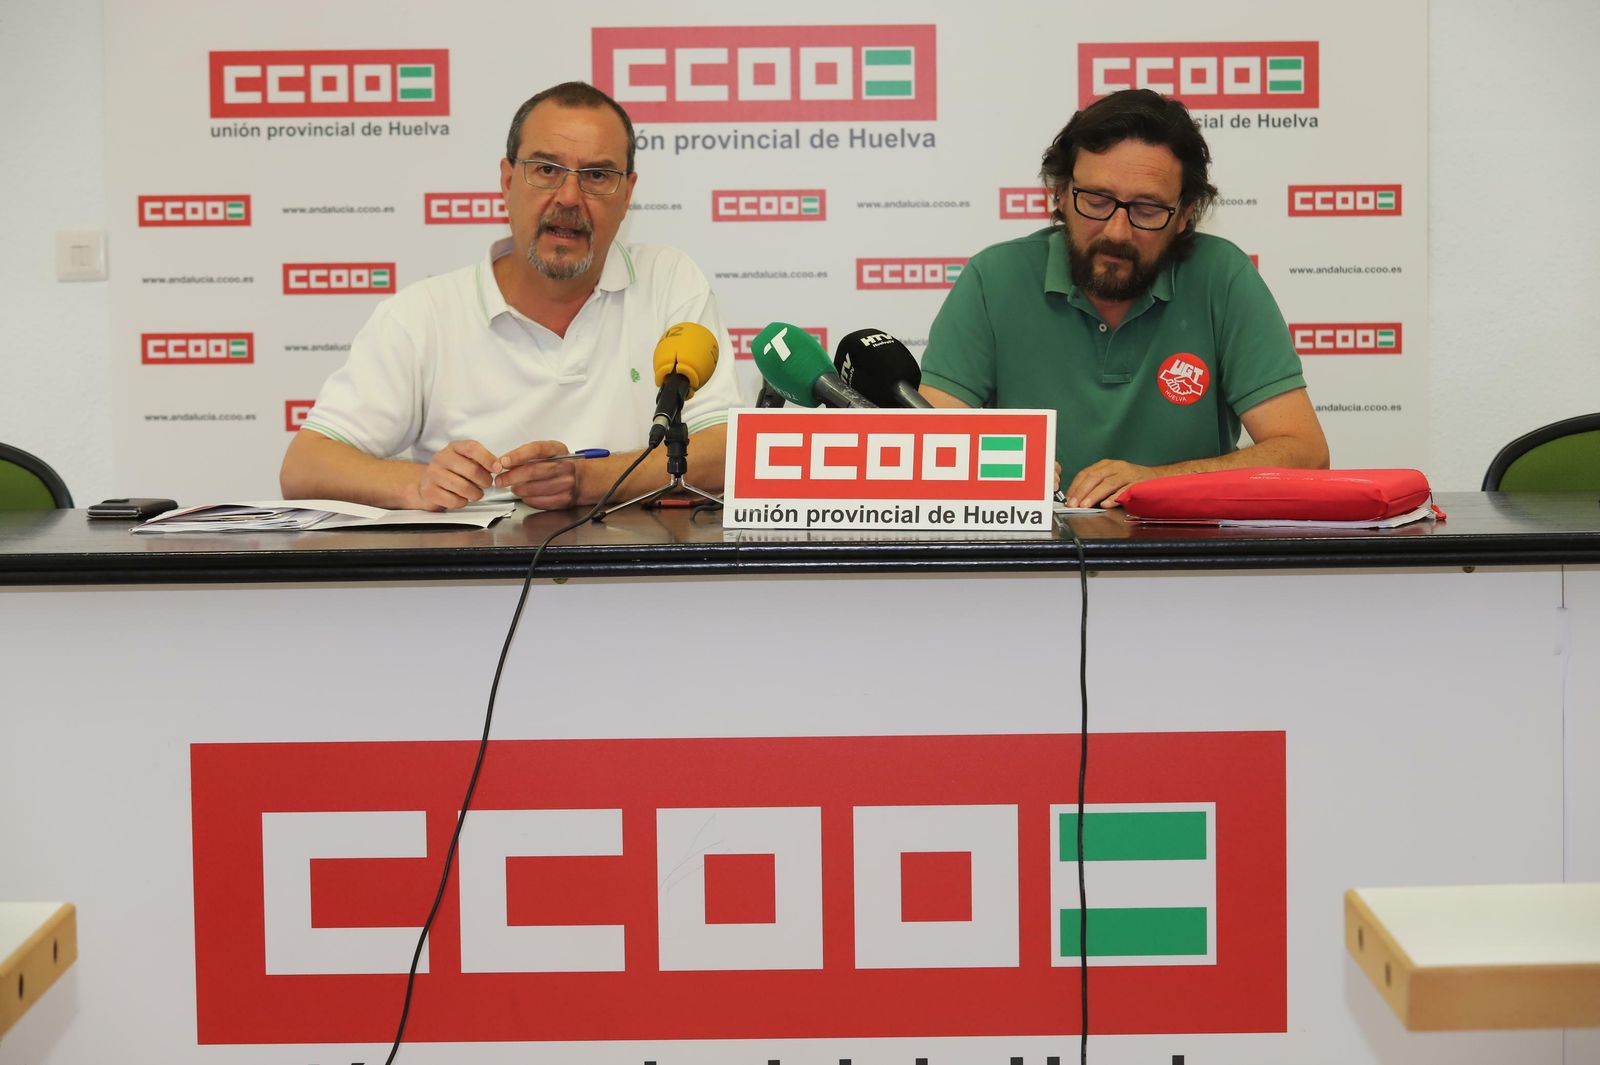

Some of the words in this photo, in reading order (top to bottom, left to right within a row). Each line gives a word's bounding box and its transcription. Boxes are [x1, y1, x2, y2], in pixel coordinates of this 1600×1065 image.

[223, 63, 392, 104] CCOO
[612, 46, 853, 102] CCOO
[1092, 56, 1261, 96] CCOO
[210, 121, 261, 138] unión
[267, 121, 355, 141] provincial
[361, 121, 383, 137] de
[388, 121, 450, 136] Huelva
[1230, 114, 1251, 129] de
[1257, 113, 1319, 128] Huelva
[675, 129, 800, 155] provincial
[810, 129, 840, 149] de
[849, 127, 936, 149] Huelva
[144, 201, 225, 221] CCOO
[719, 195, 800, 216] CCOO
[1006, 194, 1054, 213] CC
[1294, 191, 1373, 210] CCOO
[288, 269, 370, 289] CCOO
[862, 264, 943, 284] CCOO
[1288, 265, 1403, 275] www.andalucia.ccoo.es
[147, 338, 228, 359] CCOO
[1294, 329, 1376, 349] CCOO
[1169, 359, 1204, 384] UGT
[755, 433, 971, 481] CCOO
[734, 504, 798, 524] unión
[806, 504, 922, 530] provincial
[928, 505, 955, 525] de
[964, 505, 1043, 525] Huelva
[262, 803, 1020, 976] CCOO
